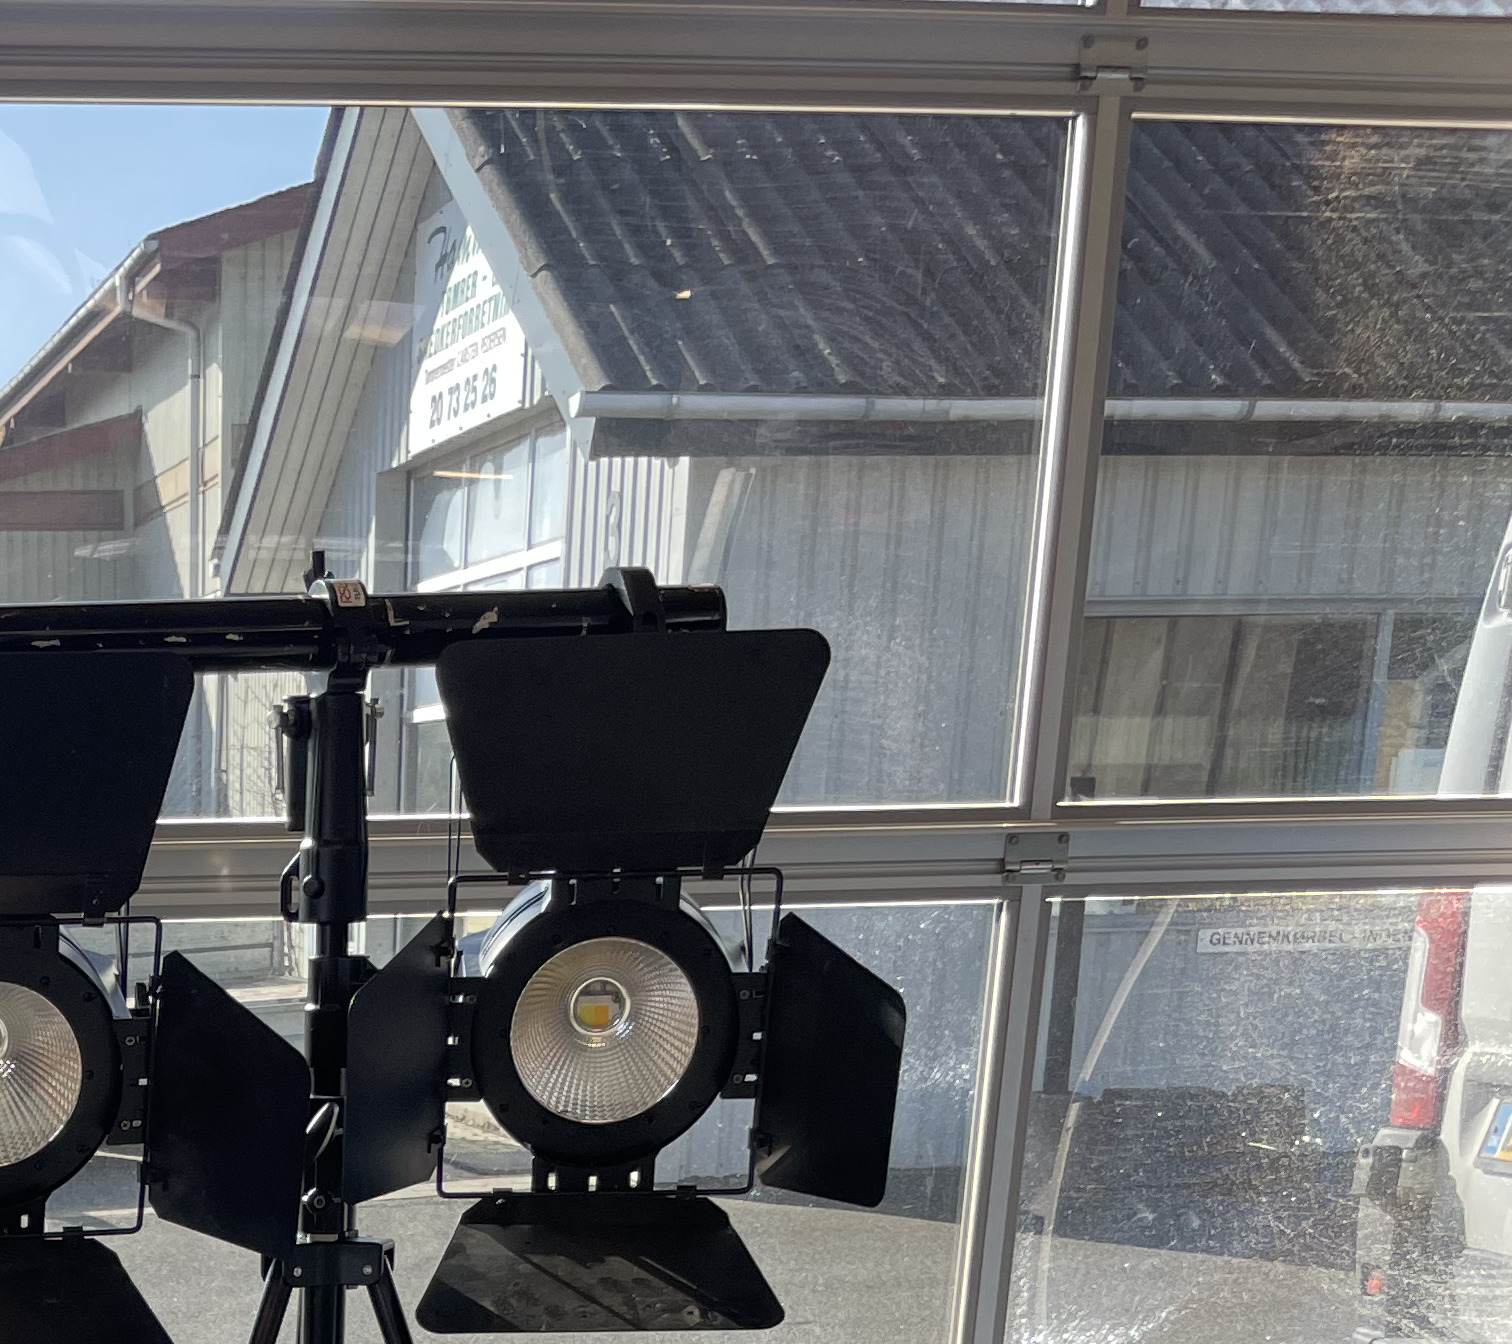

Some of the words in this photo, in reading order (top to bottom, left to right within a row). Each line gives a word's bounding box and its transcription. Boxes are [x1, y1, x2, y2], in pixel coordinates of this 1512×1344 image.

[429, 391, 444, 429] 20
[447, 382, 461, 421] 73
[463, 373, 479, 413] 25
[481, 363, 498, 404] 26
